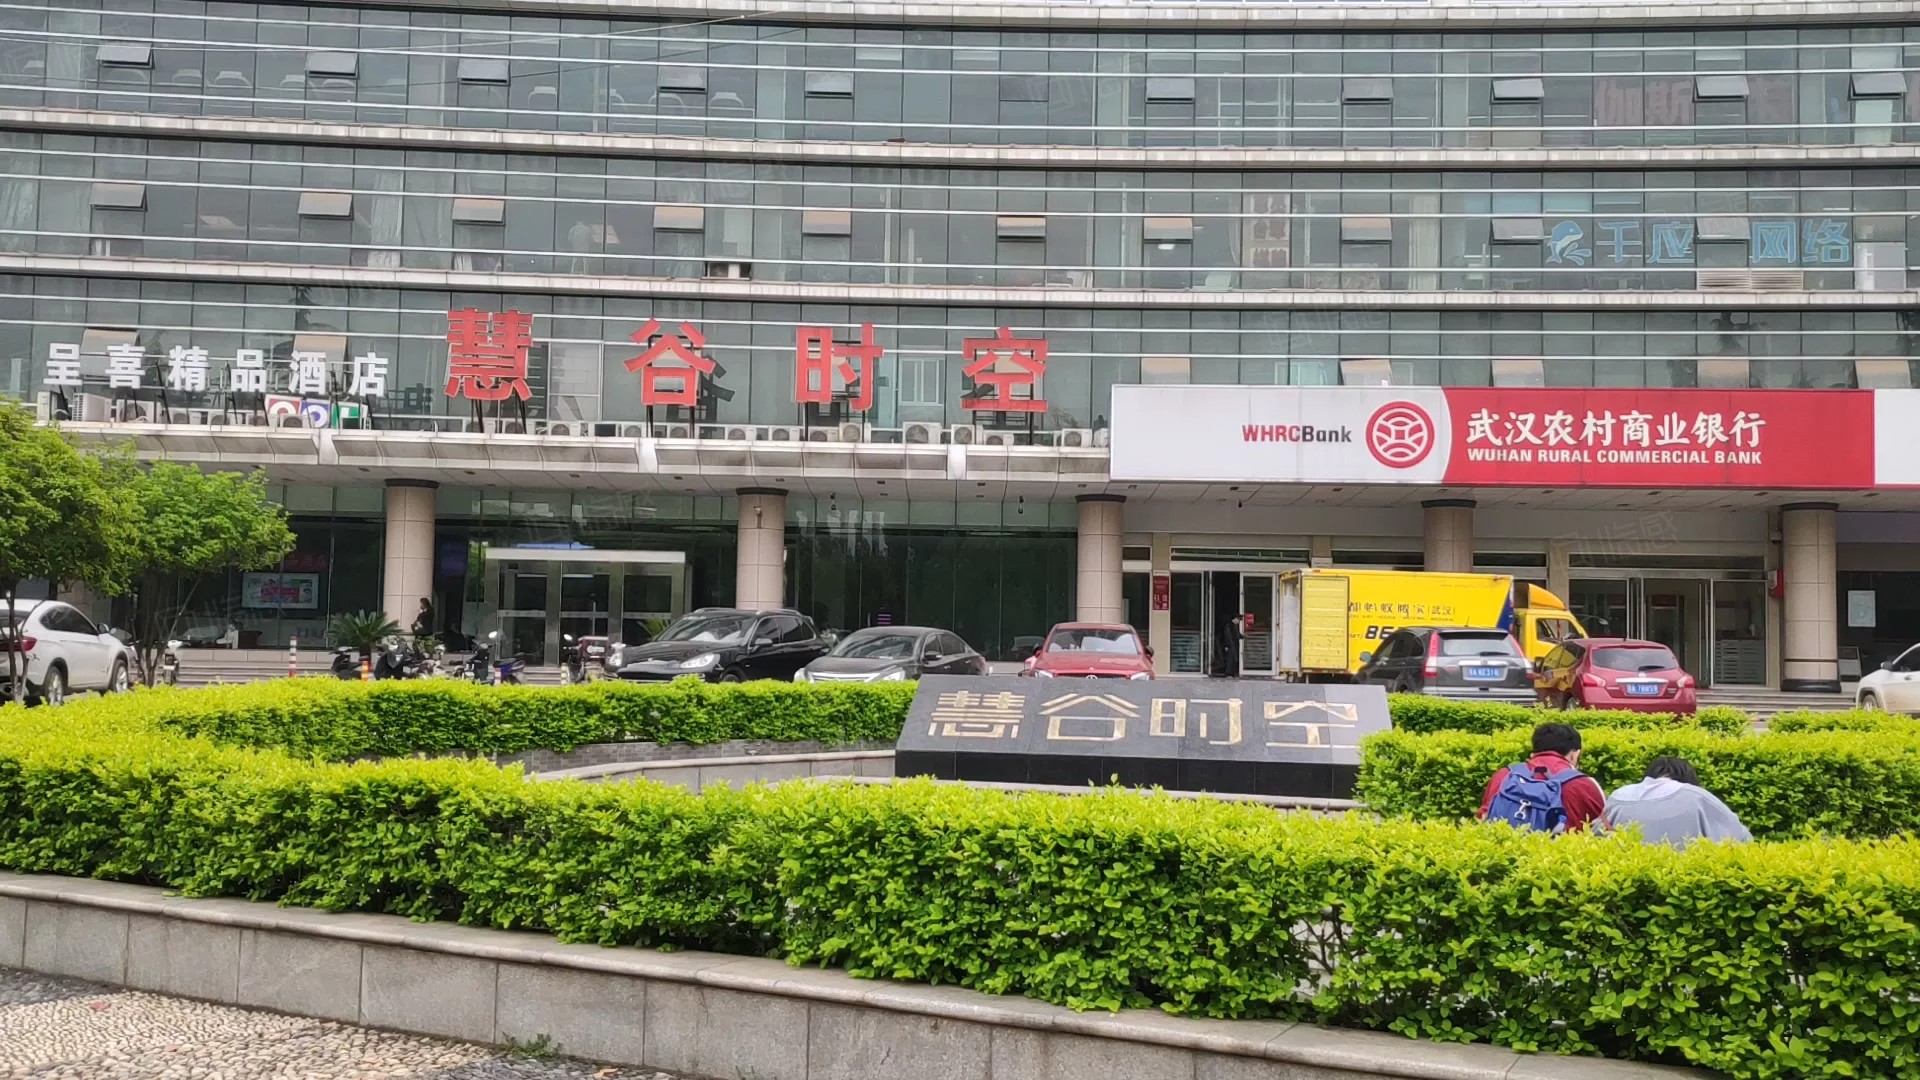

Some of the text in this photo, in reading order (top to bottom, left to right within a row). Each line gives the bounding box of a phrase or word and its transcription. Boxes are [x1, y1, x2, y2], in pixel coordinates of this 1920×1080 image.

[44, 342, 389, 397] 呈喜精品酒店
[444, 308, 1049, 412] 慧谷时空
[1242, 425, 1352, 443] WHRCBank
[1466, 408, 1766, 448] 武汉农村商业银行
[1467, 448, 1762, 465] WUHAN RURAL COMMERCIAL BANK
[928, 690, 1358, 749] 慧谷时空
